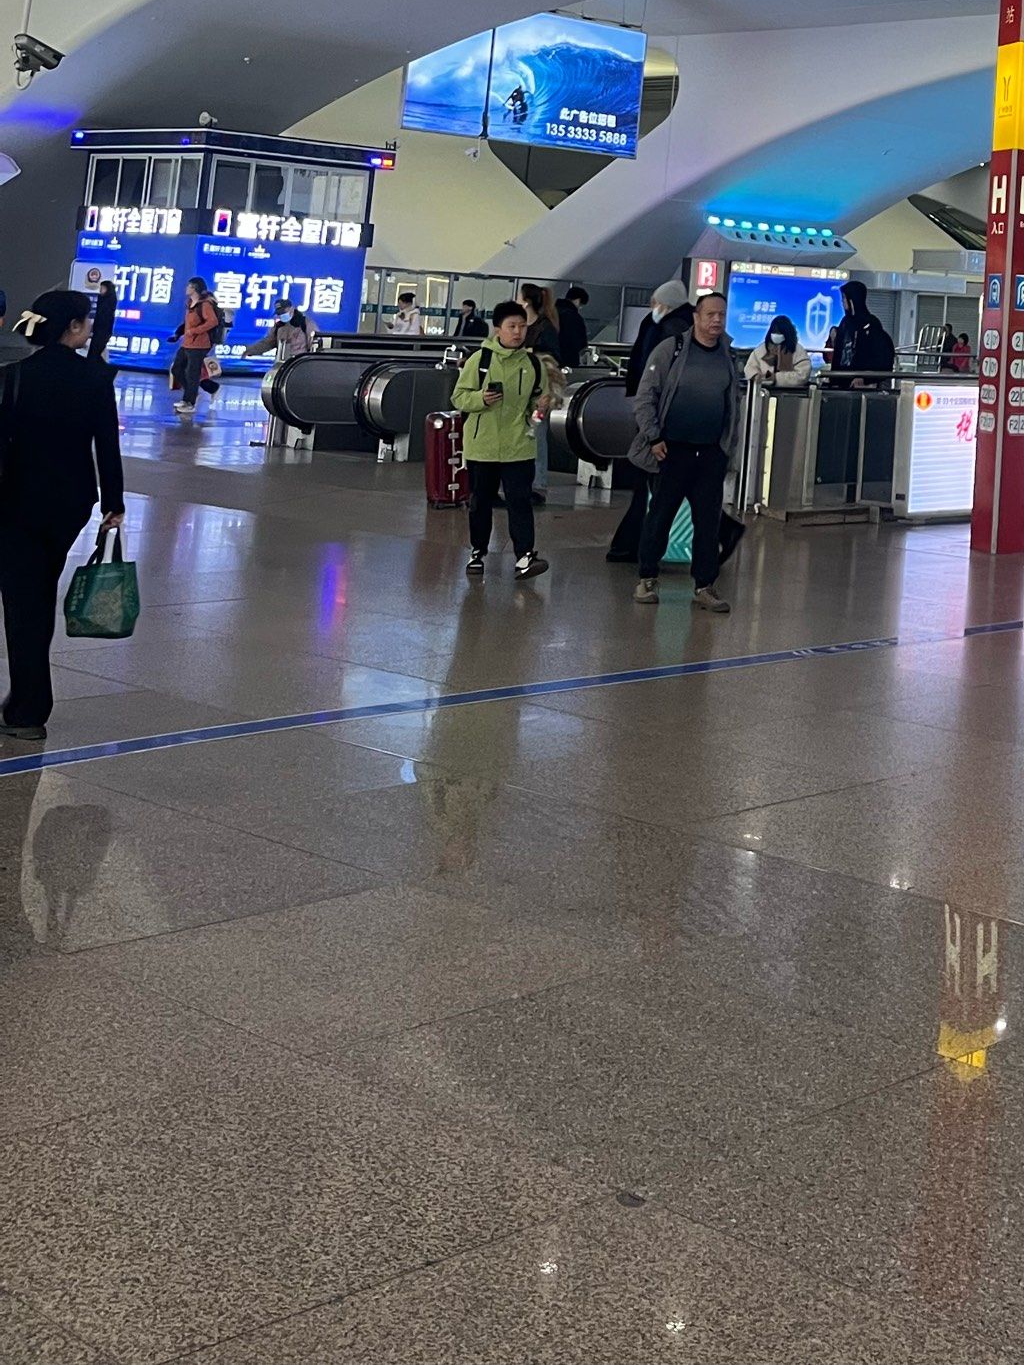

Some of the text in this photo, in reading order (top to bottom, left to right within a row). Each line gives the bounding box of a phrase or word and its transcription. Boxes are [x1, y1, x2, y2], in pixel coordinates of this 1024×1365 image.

[546, 122, 627, 146] 135 3333 5888
[991, 175, 1007, 215] H
[237, 212, 362, 247] 富轩全屋门窗
[991, 221, 1004, 235] 入口
[114, 265, 174, 304] 轩门窗
[214, 271, 344, 314] 富轩门窗
[1015, 336, 1021, 348] 2
[1014, 363, 1019, 374] 7
[1011, 391, 1019, 402] 22
[1010, 419, 1018, 430] F2
